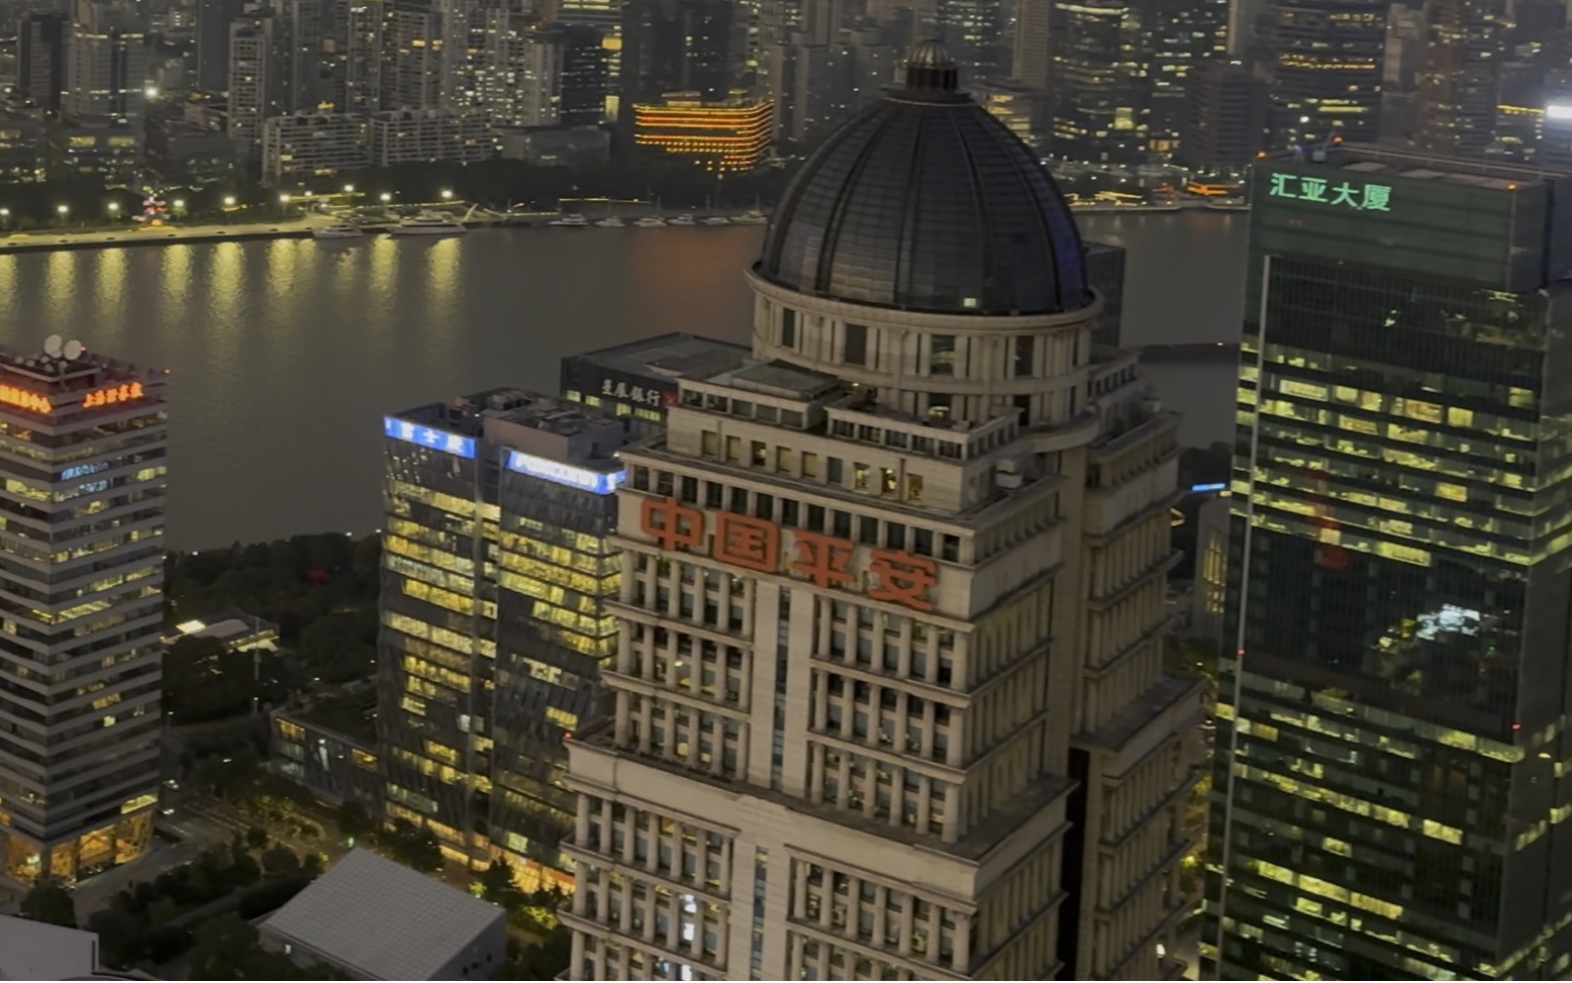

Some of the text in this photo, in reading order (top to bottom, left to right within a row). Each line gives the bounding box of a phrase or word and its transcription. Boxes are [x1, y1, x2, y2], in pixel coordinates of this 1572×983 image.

[1269, 173, 1393, 212] 汇亚大厦
[641, 496, 938, 611] 中国平安
